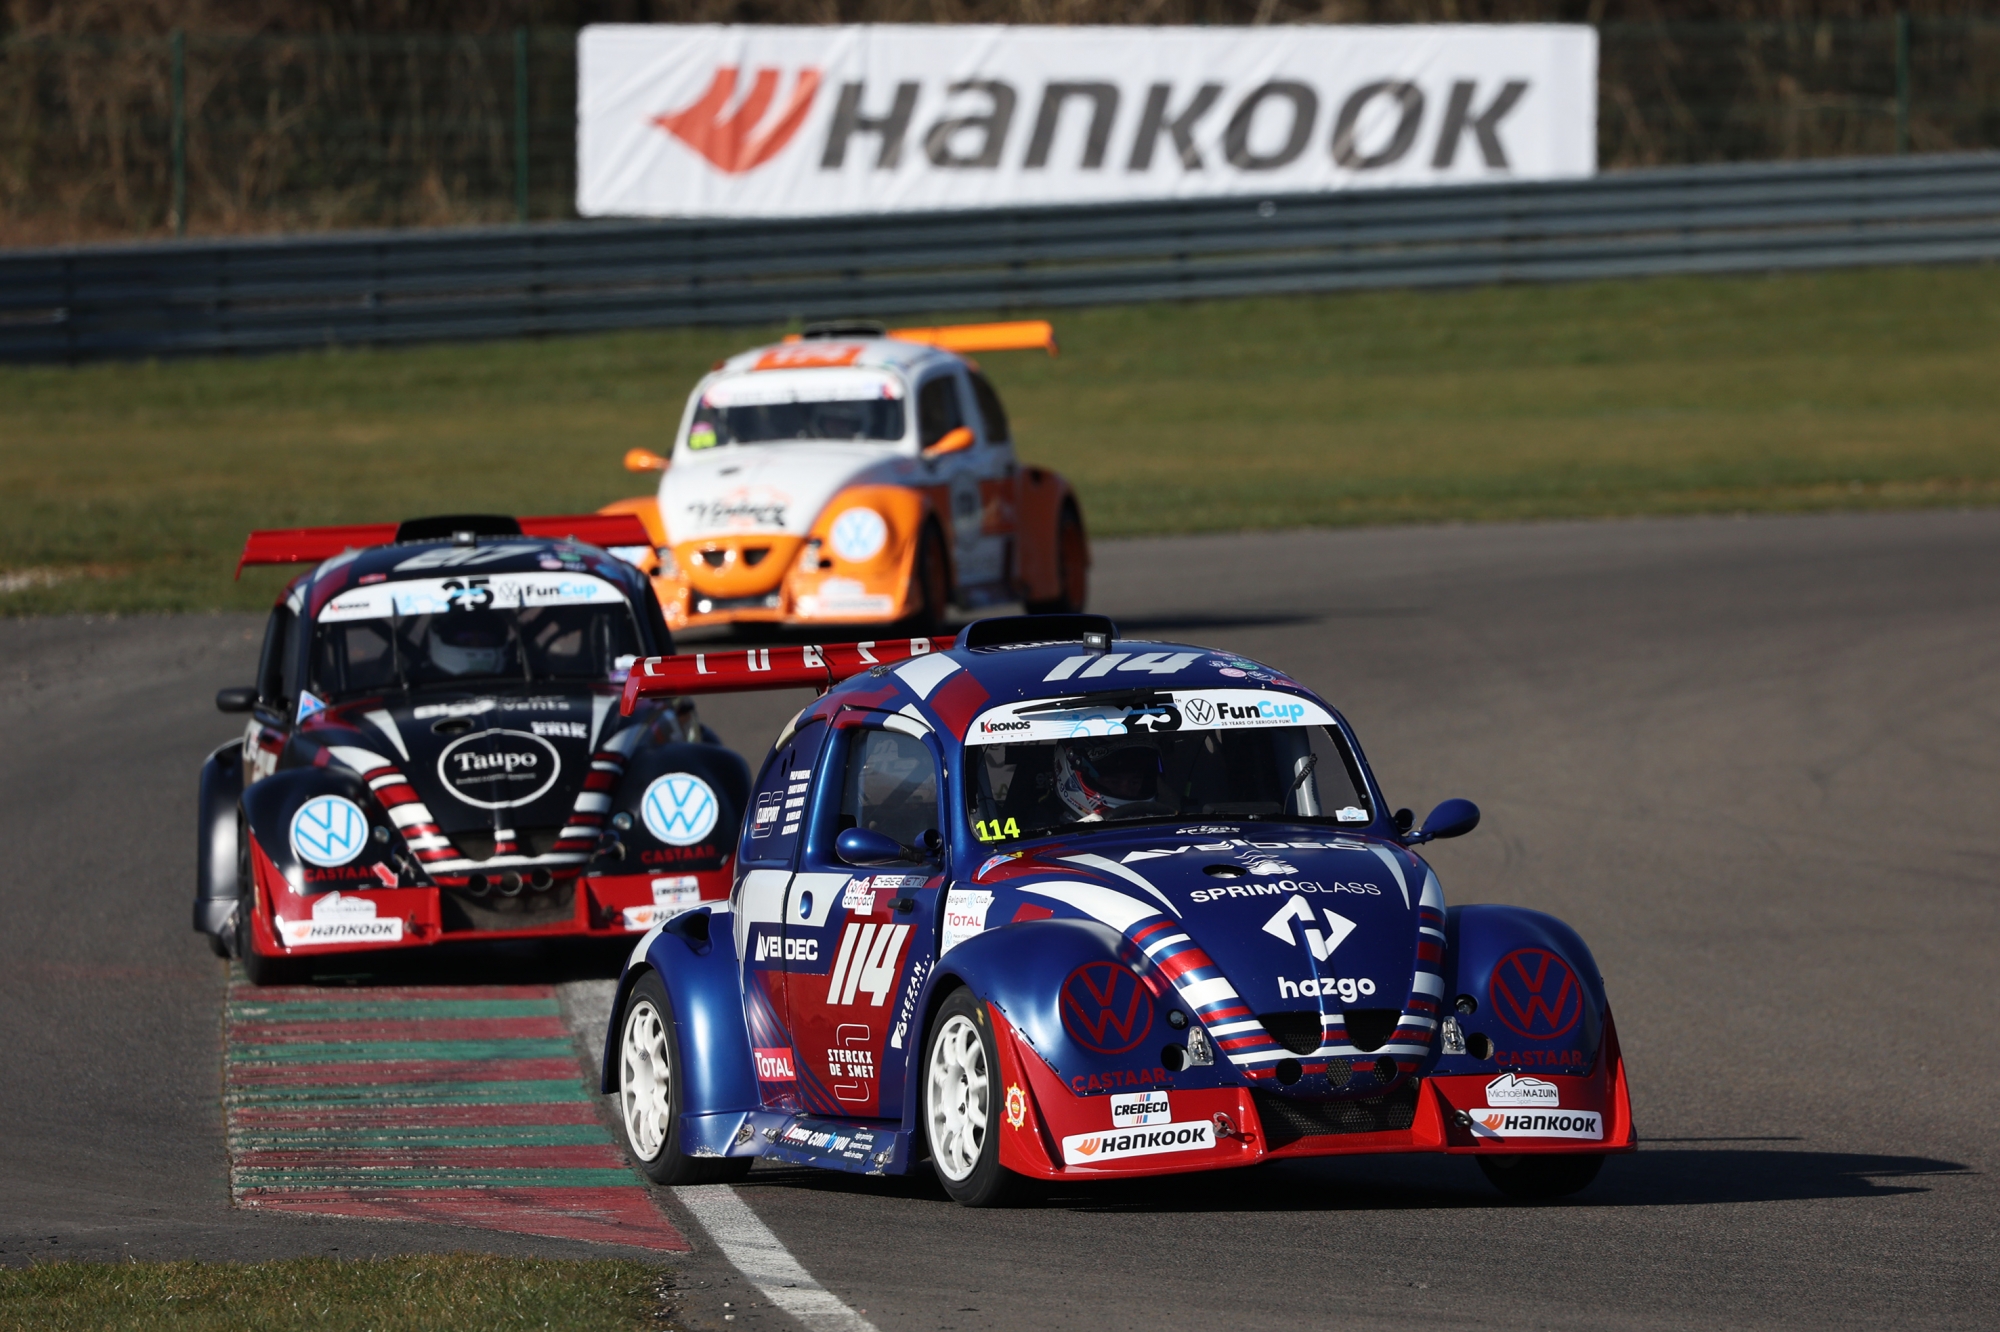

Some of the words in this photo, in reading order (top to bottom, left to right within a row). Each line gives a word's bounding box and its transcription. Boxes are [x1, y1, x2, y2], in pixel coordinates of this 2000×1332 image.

[526, 581, 598, 598] FunCup
[1042, 652, 1205, 683] 114
[1217, 701, 1305, 723] FunCup
[980, 718, 1031, 733] KRONOS
[454, 752, 537, 772] Taupo
[975, 817, 1021, 843] 114
[844, 893, 874, 912] compact
[826, 922, 911, 1007] 114
[1277, 976, 1376, 1002] hazgo
[827, 1048, 873, 1064] STERCKX
[829, 1063, 842, 1077] DE
[847, 1064, 874, 1079] SMET
[1114, 1101, 1168, 1116] CREDECO
